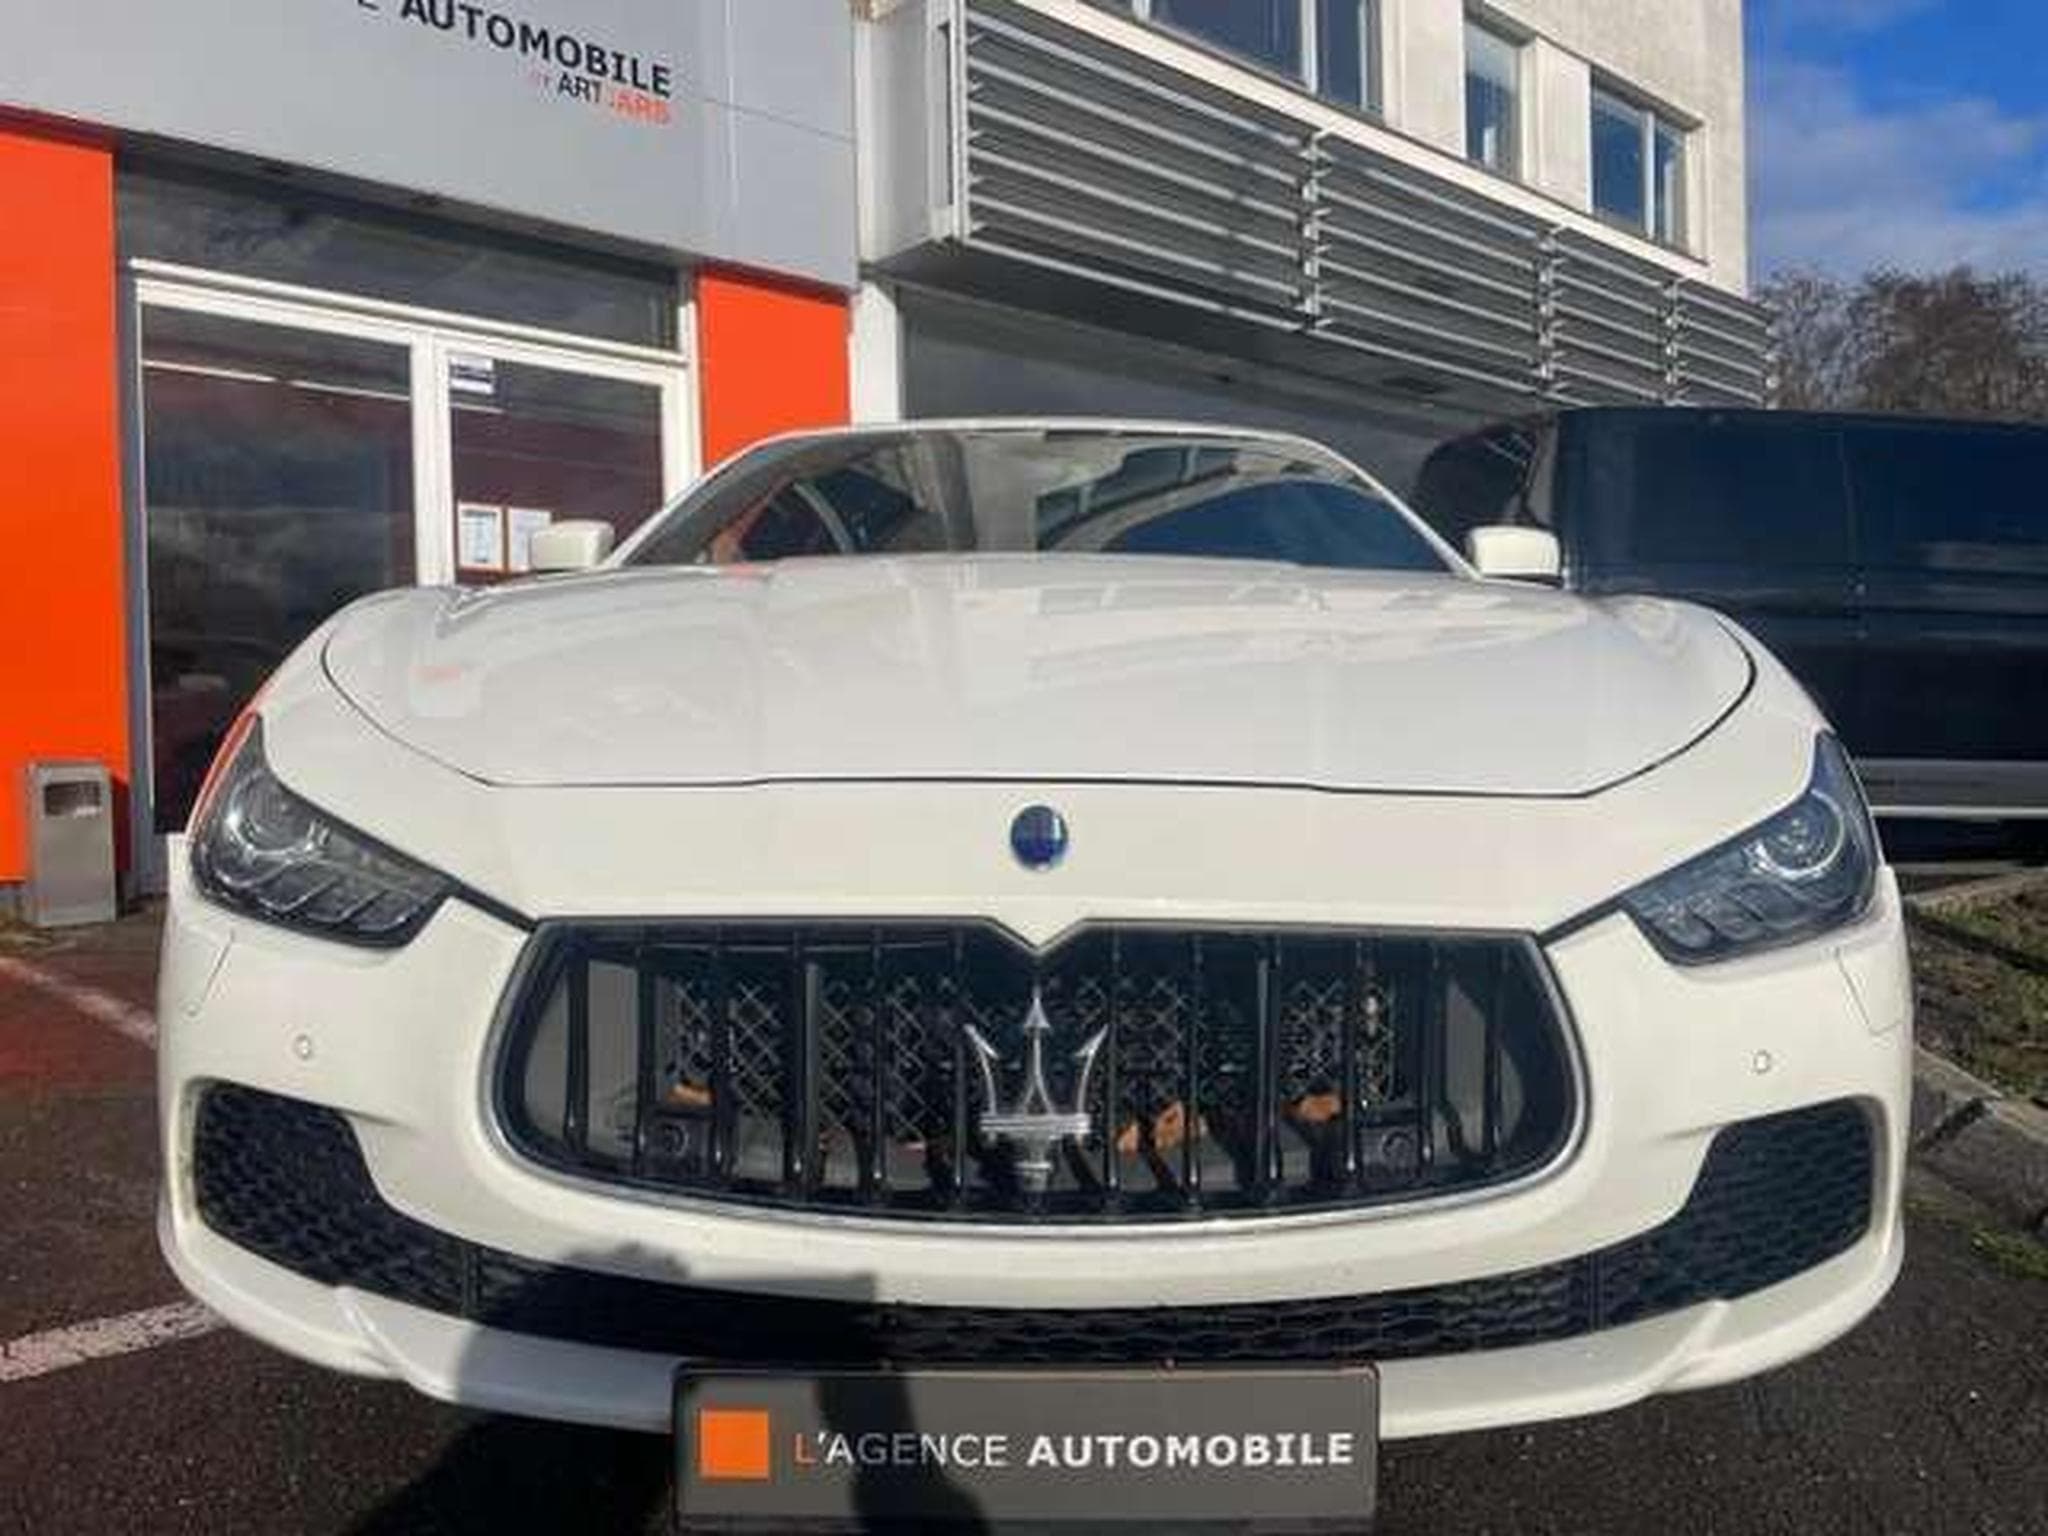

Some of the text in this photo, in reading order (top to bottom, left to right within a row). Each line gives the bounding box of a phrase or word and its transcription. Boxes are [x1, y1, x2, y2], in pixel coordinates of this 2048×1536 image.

[401, 0, 671, 98] AUTOMOBILE
[794, 1431, 1354, 1468] L'AGENCE AUTOMOBILE
